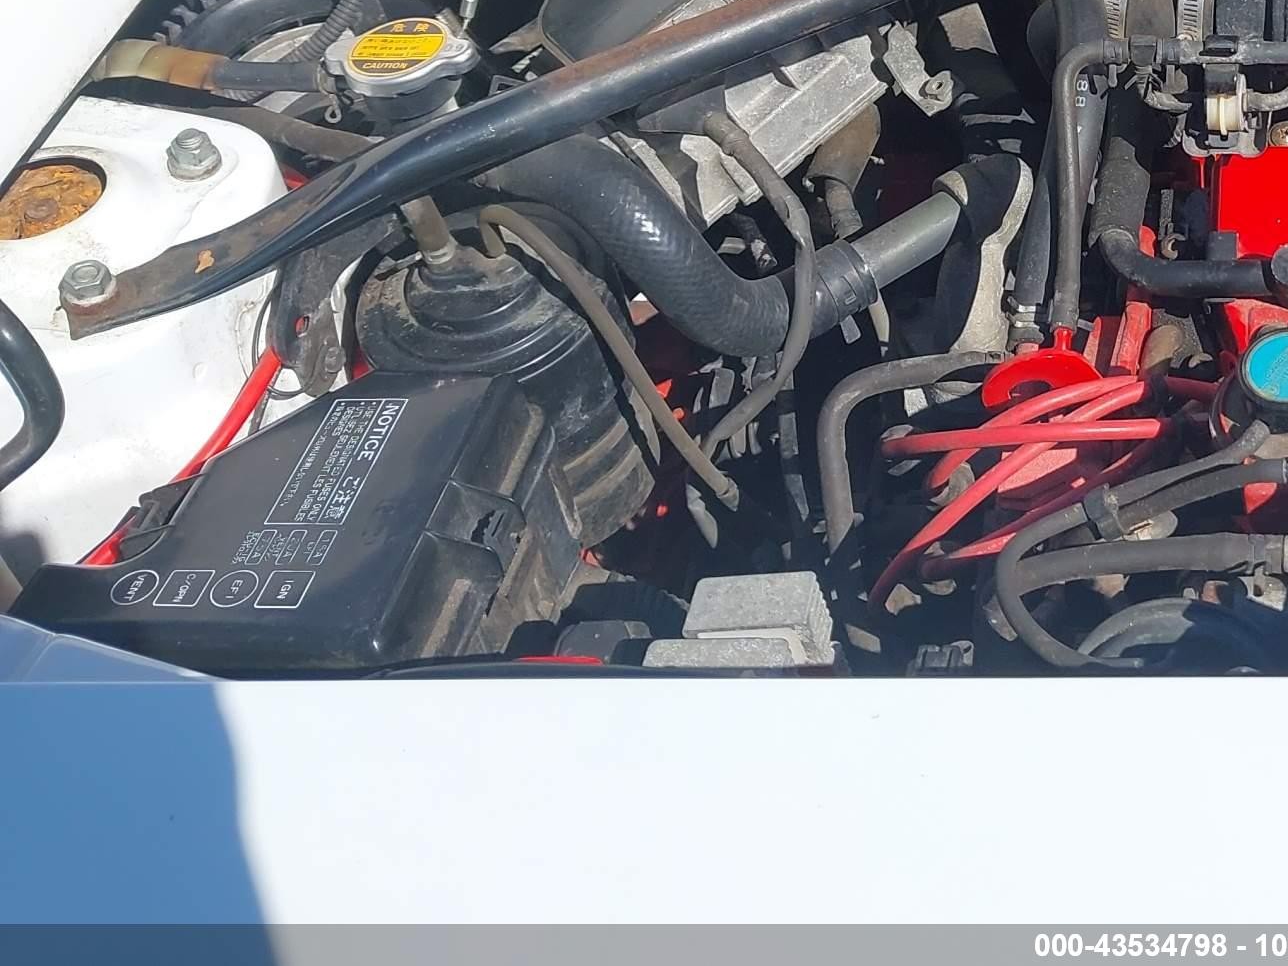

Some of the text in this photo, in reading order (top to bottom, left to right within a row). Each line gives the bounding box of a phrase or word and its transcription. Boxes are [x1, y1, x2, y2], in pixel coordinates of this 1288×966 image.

[322, 405, 400, 519] NOTICE ご注意
[330, 435, 360, 475] DESIGNATED
[316, 478, 336, 500] FUSES
[292, 489, 318, 521] FUSIBLES
[304, 504, 322, 520] ONLY
[123, 574, 147, 601] VENT
[172, 573, 197, 602] C/OPN
[225, 579, 243, 599] EFI
[276, 580, 295, 599] IGN
